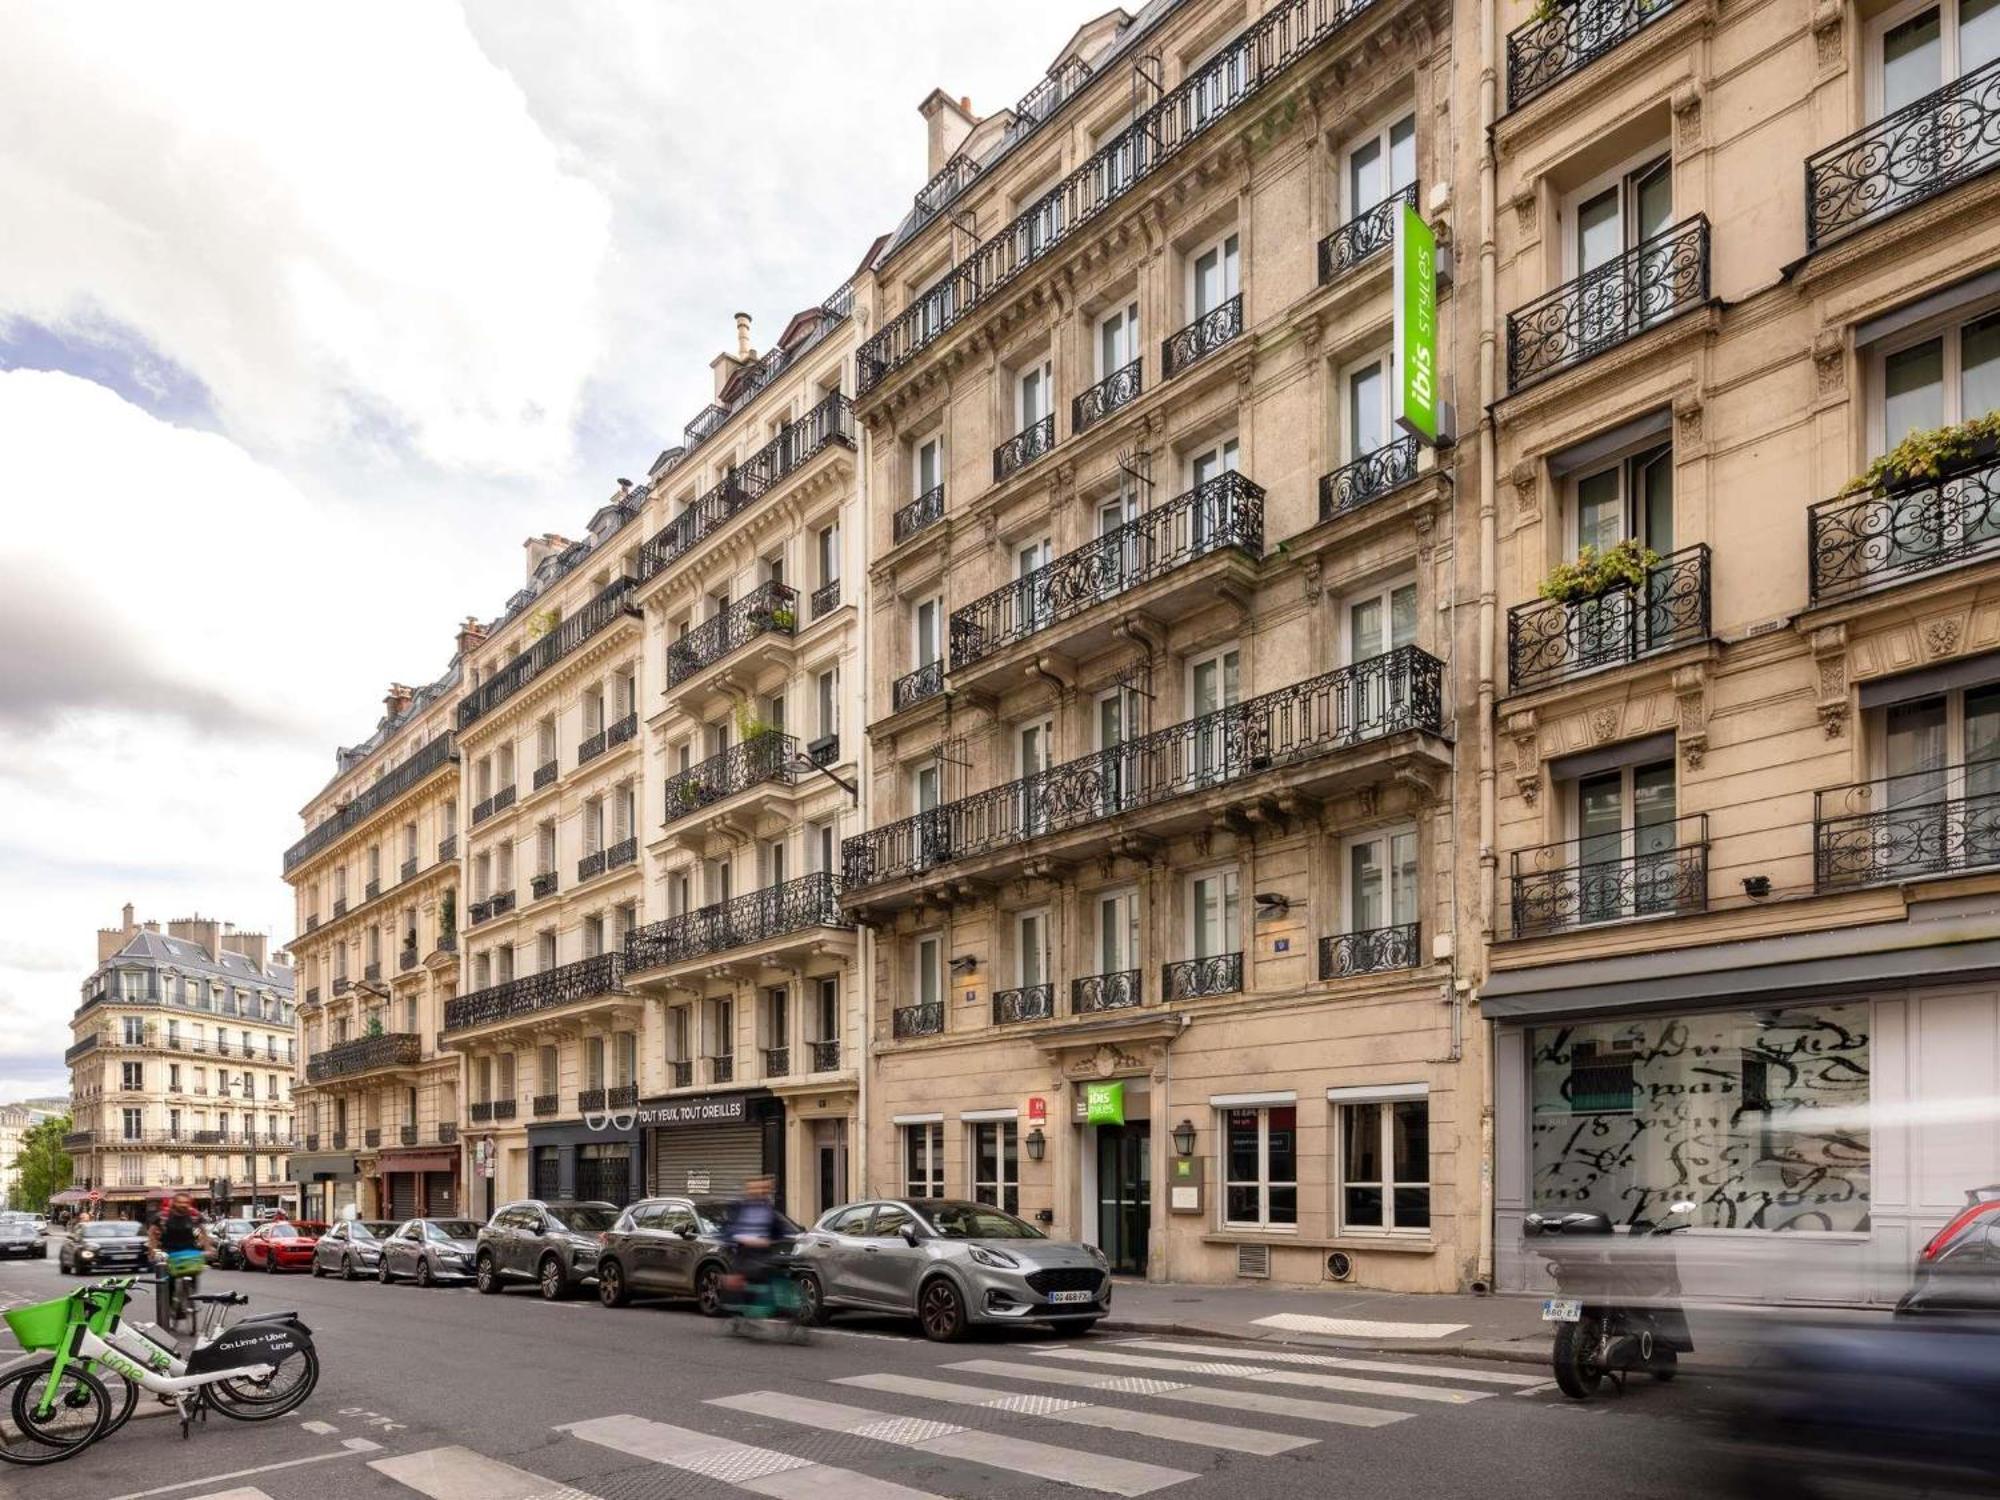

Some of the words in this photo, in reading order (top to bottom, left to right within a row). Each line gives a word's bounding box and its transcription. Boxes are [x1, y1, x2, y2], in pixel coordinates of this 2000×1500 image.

[1410, 343, 1432, 410] ibis
[638, 1109, 657, 1122] TOUT
[681, 1106, 701, 1119] TOUT
[702, 1103, 741, 1118] OREILLES
[235, 1338, 257, 1347] Lime
[265, 1332, 287, 1342] Uber
[271, 1341, 294, 1350] Lime
[102, 1349, 144, 1379] Lime
